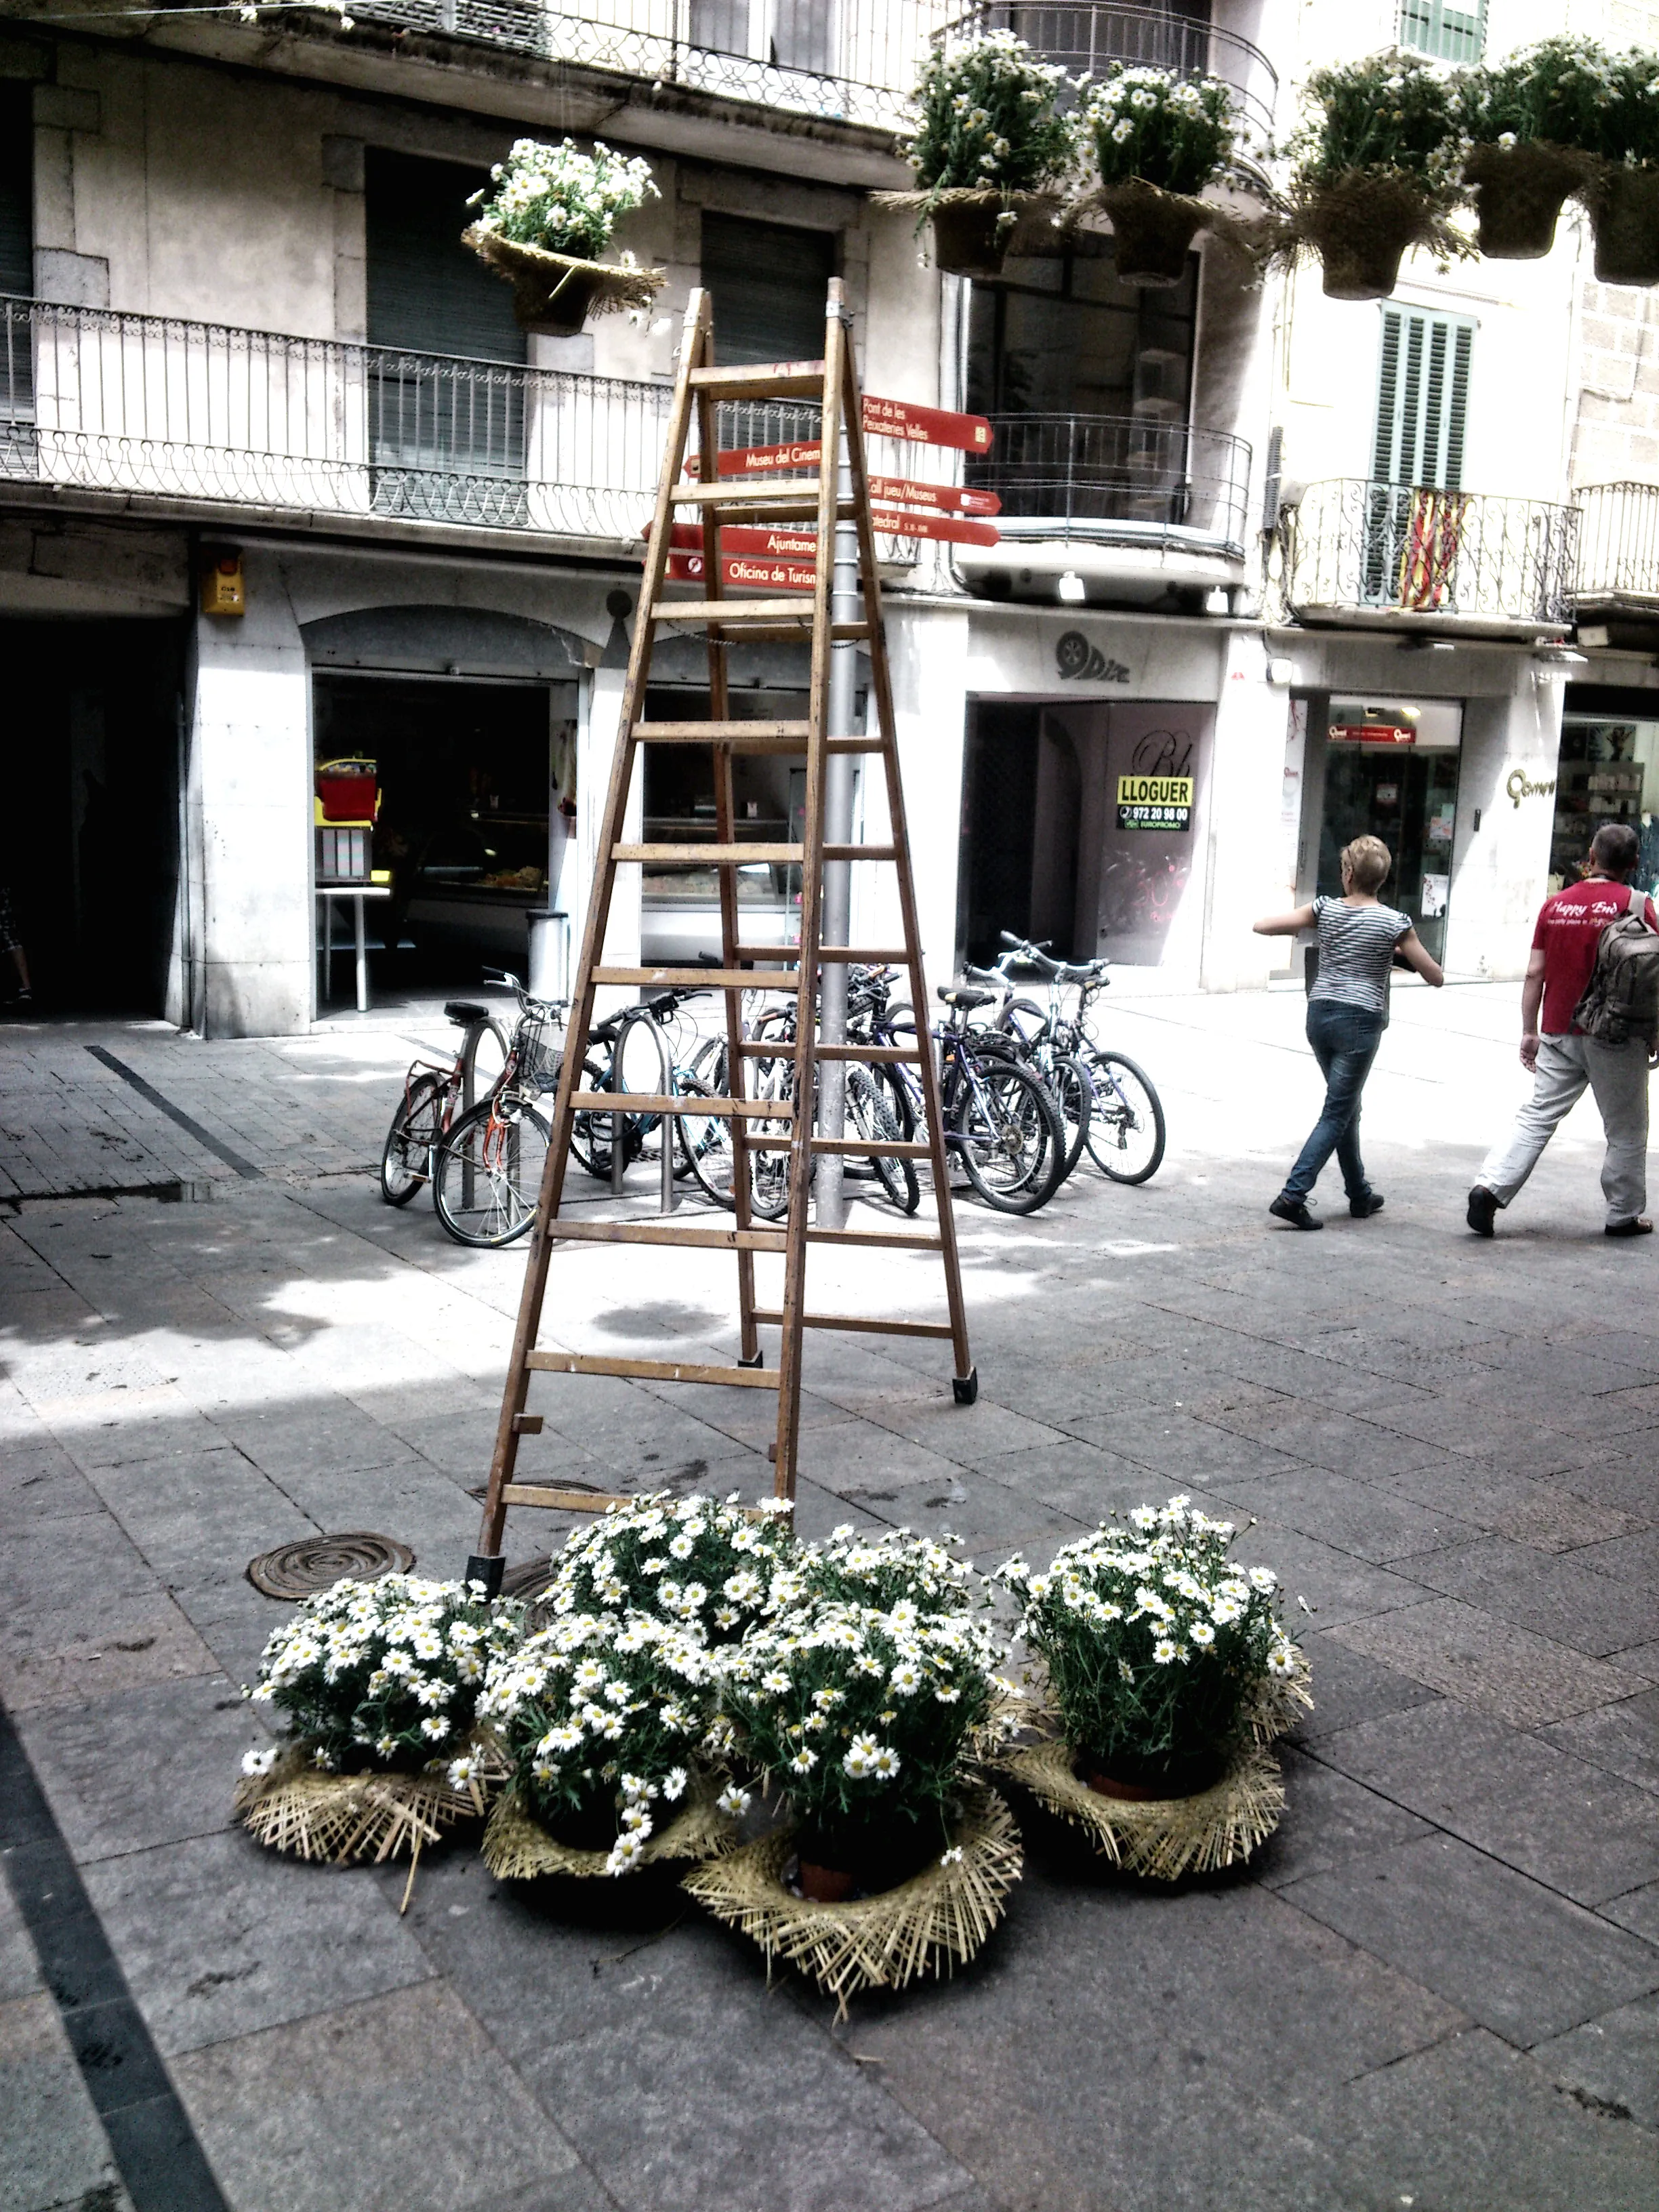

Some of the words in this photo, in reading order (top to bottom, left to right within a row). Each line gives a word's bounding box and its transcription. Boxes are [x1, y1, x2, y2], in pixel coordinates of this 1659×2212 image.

[863, 398, 880, 415] Pont
[882, 401, 893, 417] de
[894, 403, 905, 420] les
[905, 422, 928, 441] Velles
[745, 453, 774, 468] Museu
[775, 447, 790, 464] del
[791, 447, 821, 463] Cinem
[868, 477, 881, 494] all
[872, 513, 900, 530] atedral
[767, 534, 817, 554] Ajuntame
[729, 562, 769, 581] Oficina
[771, 565, 785, 582] de
[1122, 780, 1188, 802] LLOGUER
[1132, 806, 1149, 819] 972
[1151, 807, 1162, 820] 20
[1164, 807, 1175, 821] 98
[1176, 808, 1188, 821] 00
[1549, 901, 1588, 916] Happy
[1591, 901, 1618, 915] End
